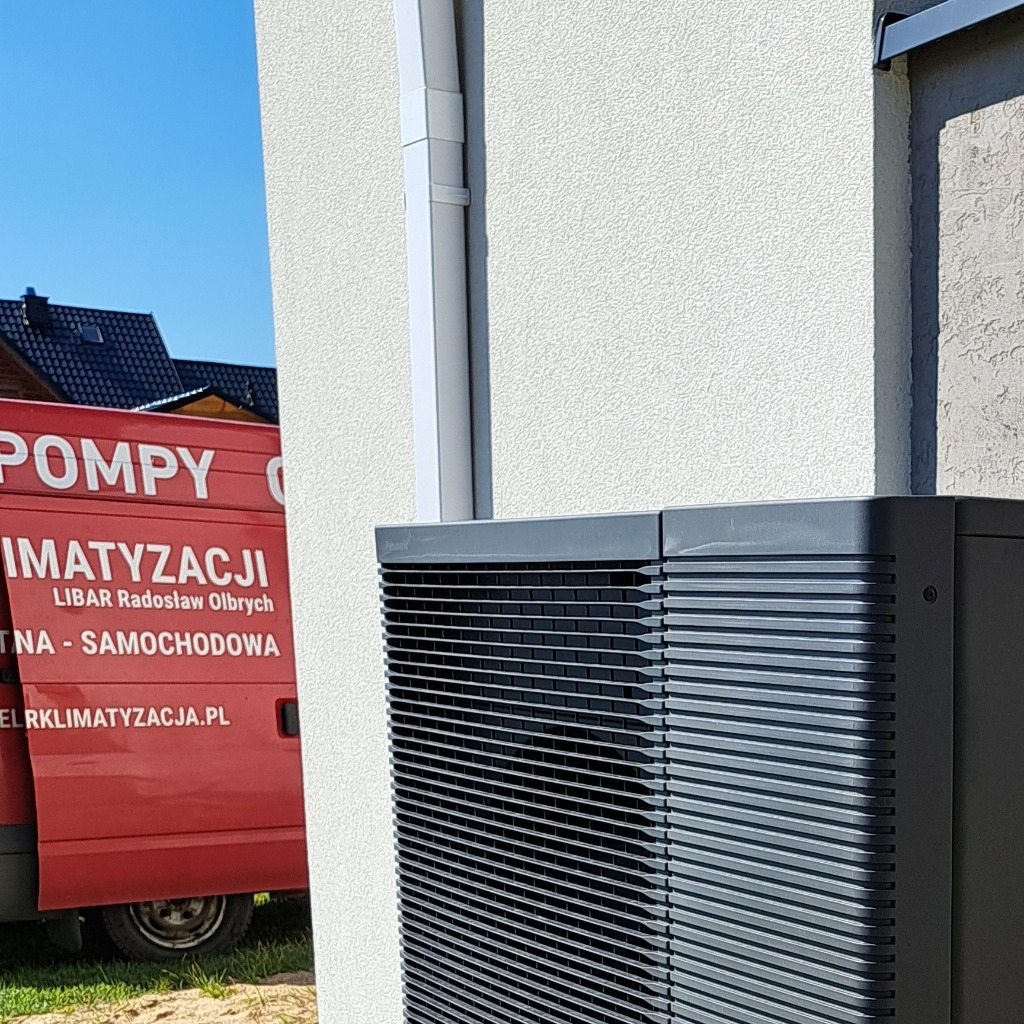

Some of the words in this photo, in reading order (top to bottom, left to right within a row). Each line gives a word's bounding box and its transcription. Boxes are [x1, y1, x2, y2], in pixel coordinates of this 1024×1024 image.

[0, 430, 215, 499] POMPY
[2, 536, 269, 588] IMATYZACJI
[53, 587, 112, 608] LIBAR
[117, 588, 203, 611] Radosław
[208, 592, 274, 616] Olbrych
[81, 629, 281, 657] SAMOCHODOWA
